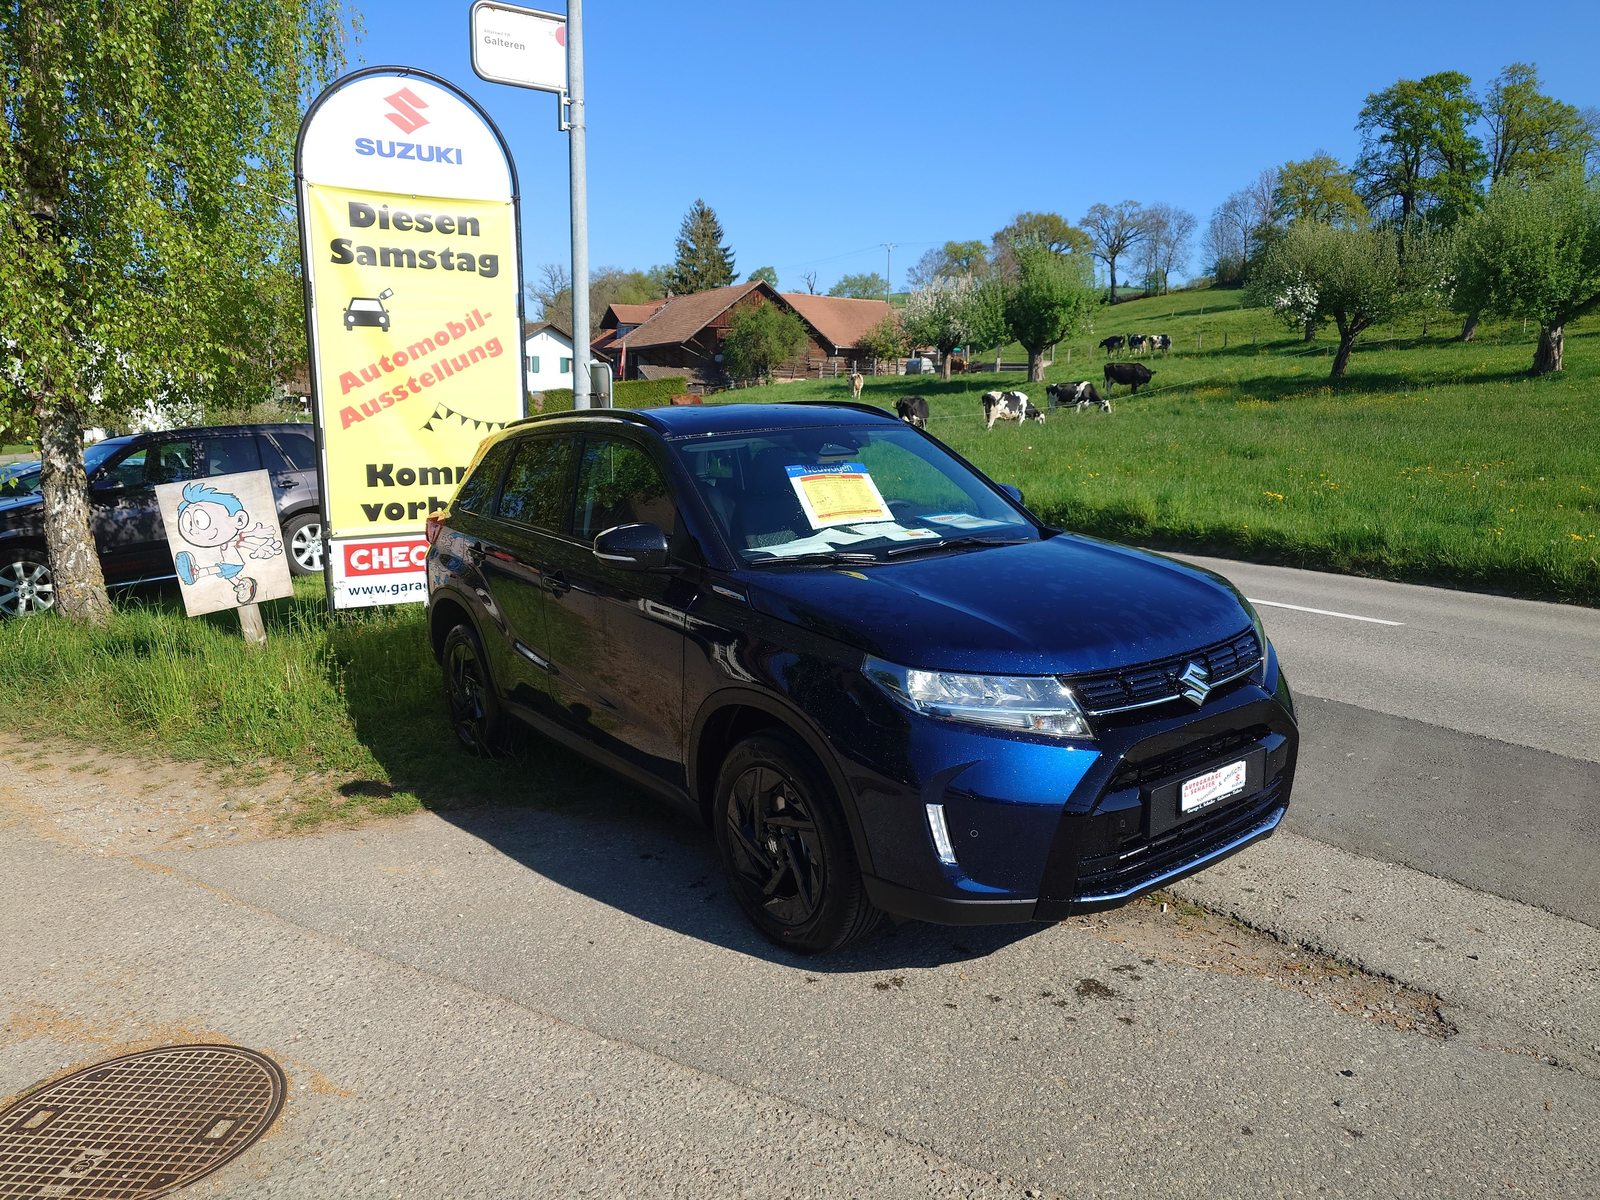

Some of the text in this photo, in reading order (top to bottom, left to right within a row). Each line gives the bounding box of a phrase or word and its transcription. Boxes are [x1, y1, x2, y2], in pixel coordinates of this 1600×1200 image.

[484, 35, 526, 51] Galteren
[354, 137, 463, 165] SUZUKI
[347, 201, 481, 237] Diesen
[330, 238, 499, 279] Samstag
[339, 308, 493, 396] Automobil-
[339, 336, 504, 431] Ausstellung
[349, 545, 427, 571] CHEC
